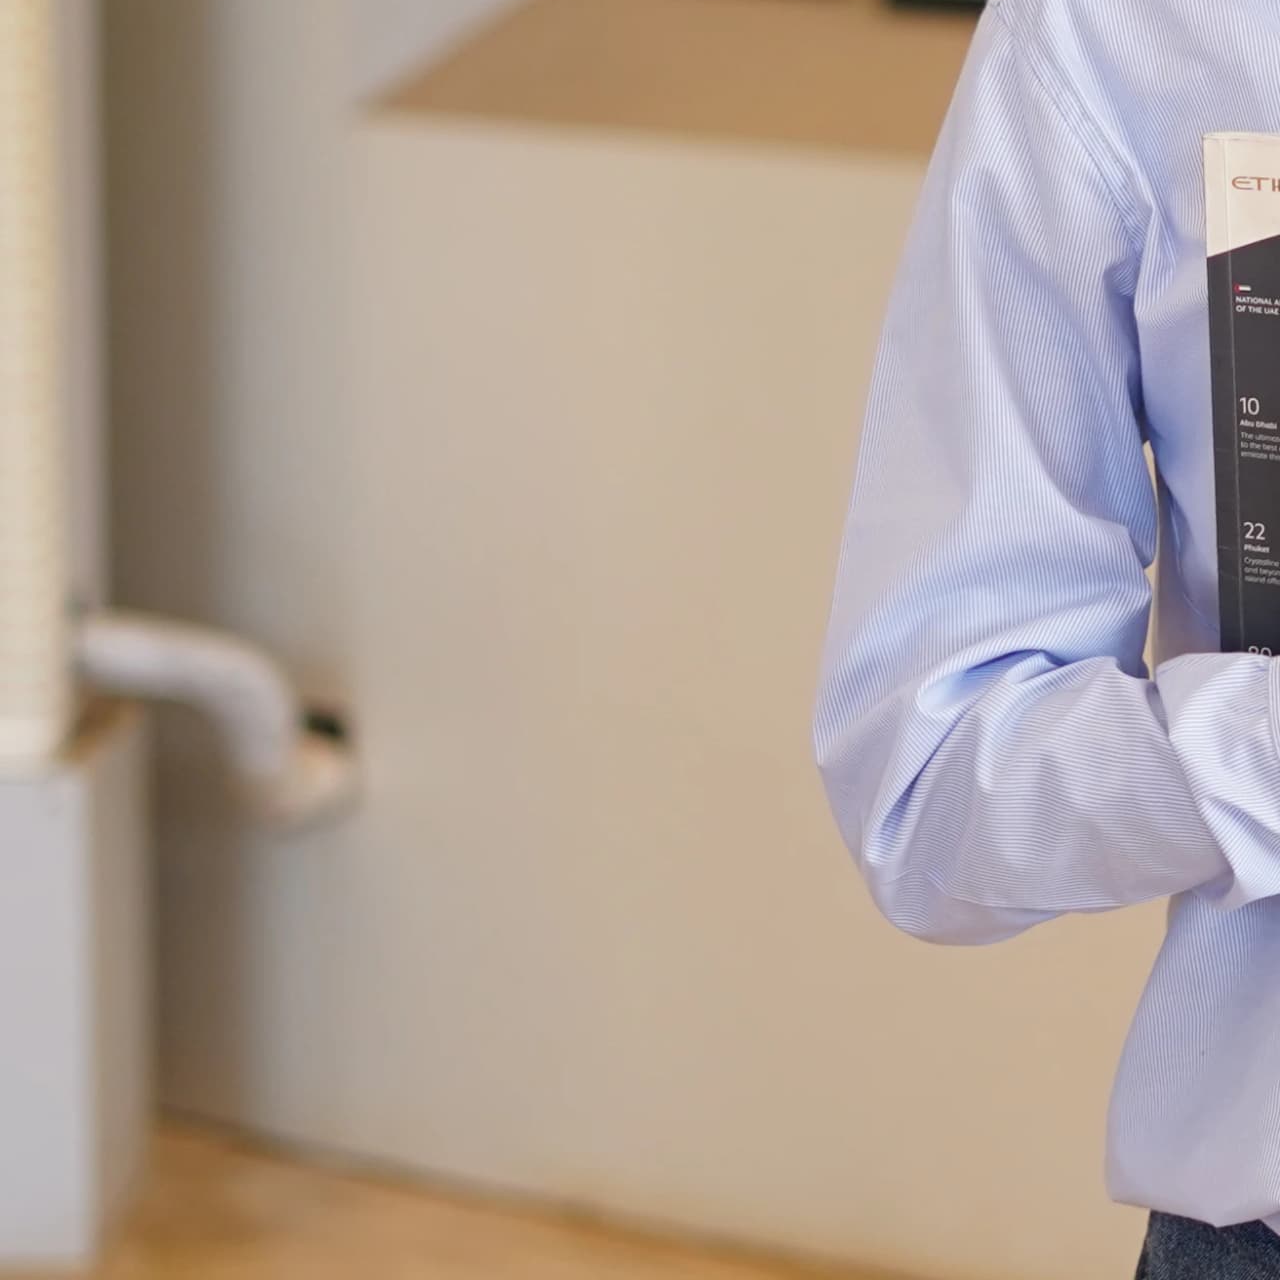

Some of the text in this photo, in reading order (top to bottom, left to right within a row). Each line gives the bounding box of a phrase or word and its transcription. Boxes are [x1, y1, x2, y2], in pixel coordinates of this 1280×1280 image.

[1235, 296, 1272, 305] NATIONAL
[1248, 306, 1262, 314] THE
[1264, 307, 1280, 315] UAE
[1239, 397, 1260, 415] 10
[1243, 522, 1266, 540] 22
